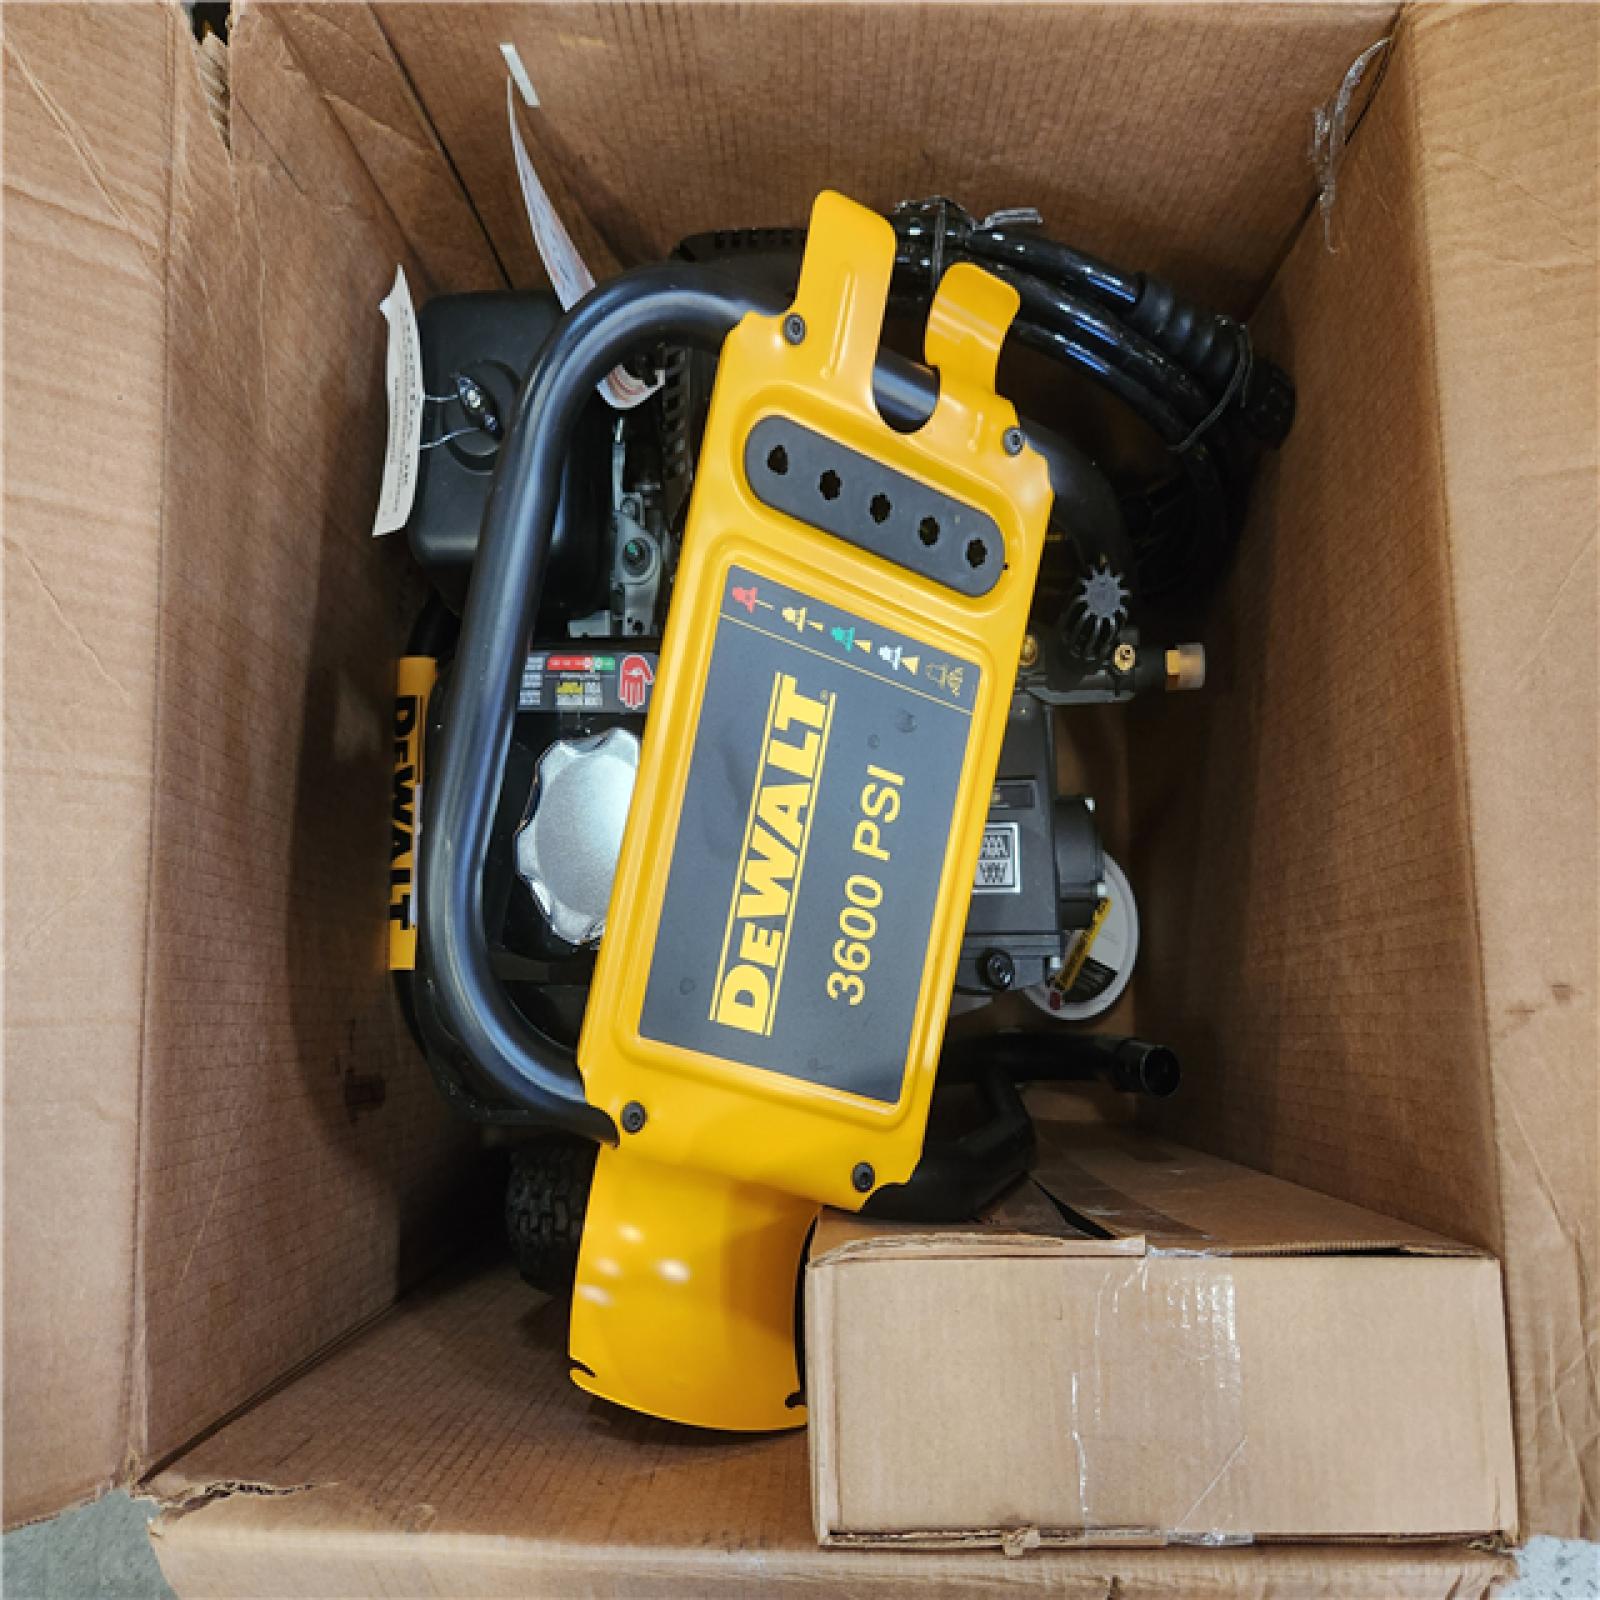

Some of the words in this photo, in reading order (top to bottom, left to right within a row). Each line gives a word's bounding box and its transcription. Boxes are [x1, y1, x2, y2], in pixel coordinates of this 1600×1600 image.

[715, 673, 833, 1034] DEWALT
[852, 764, 906, 862] PSI
[827, 873, 884, 1006] 3600
